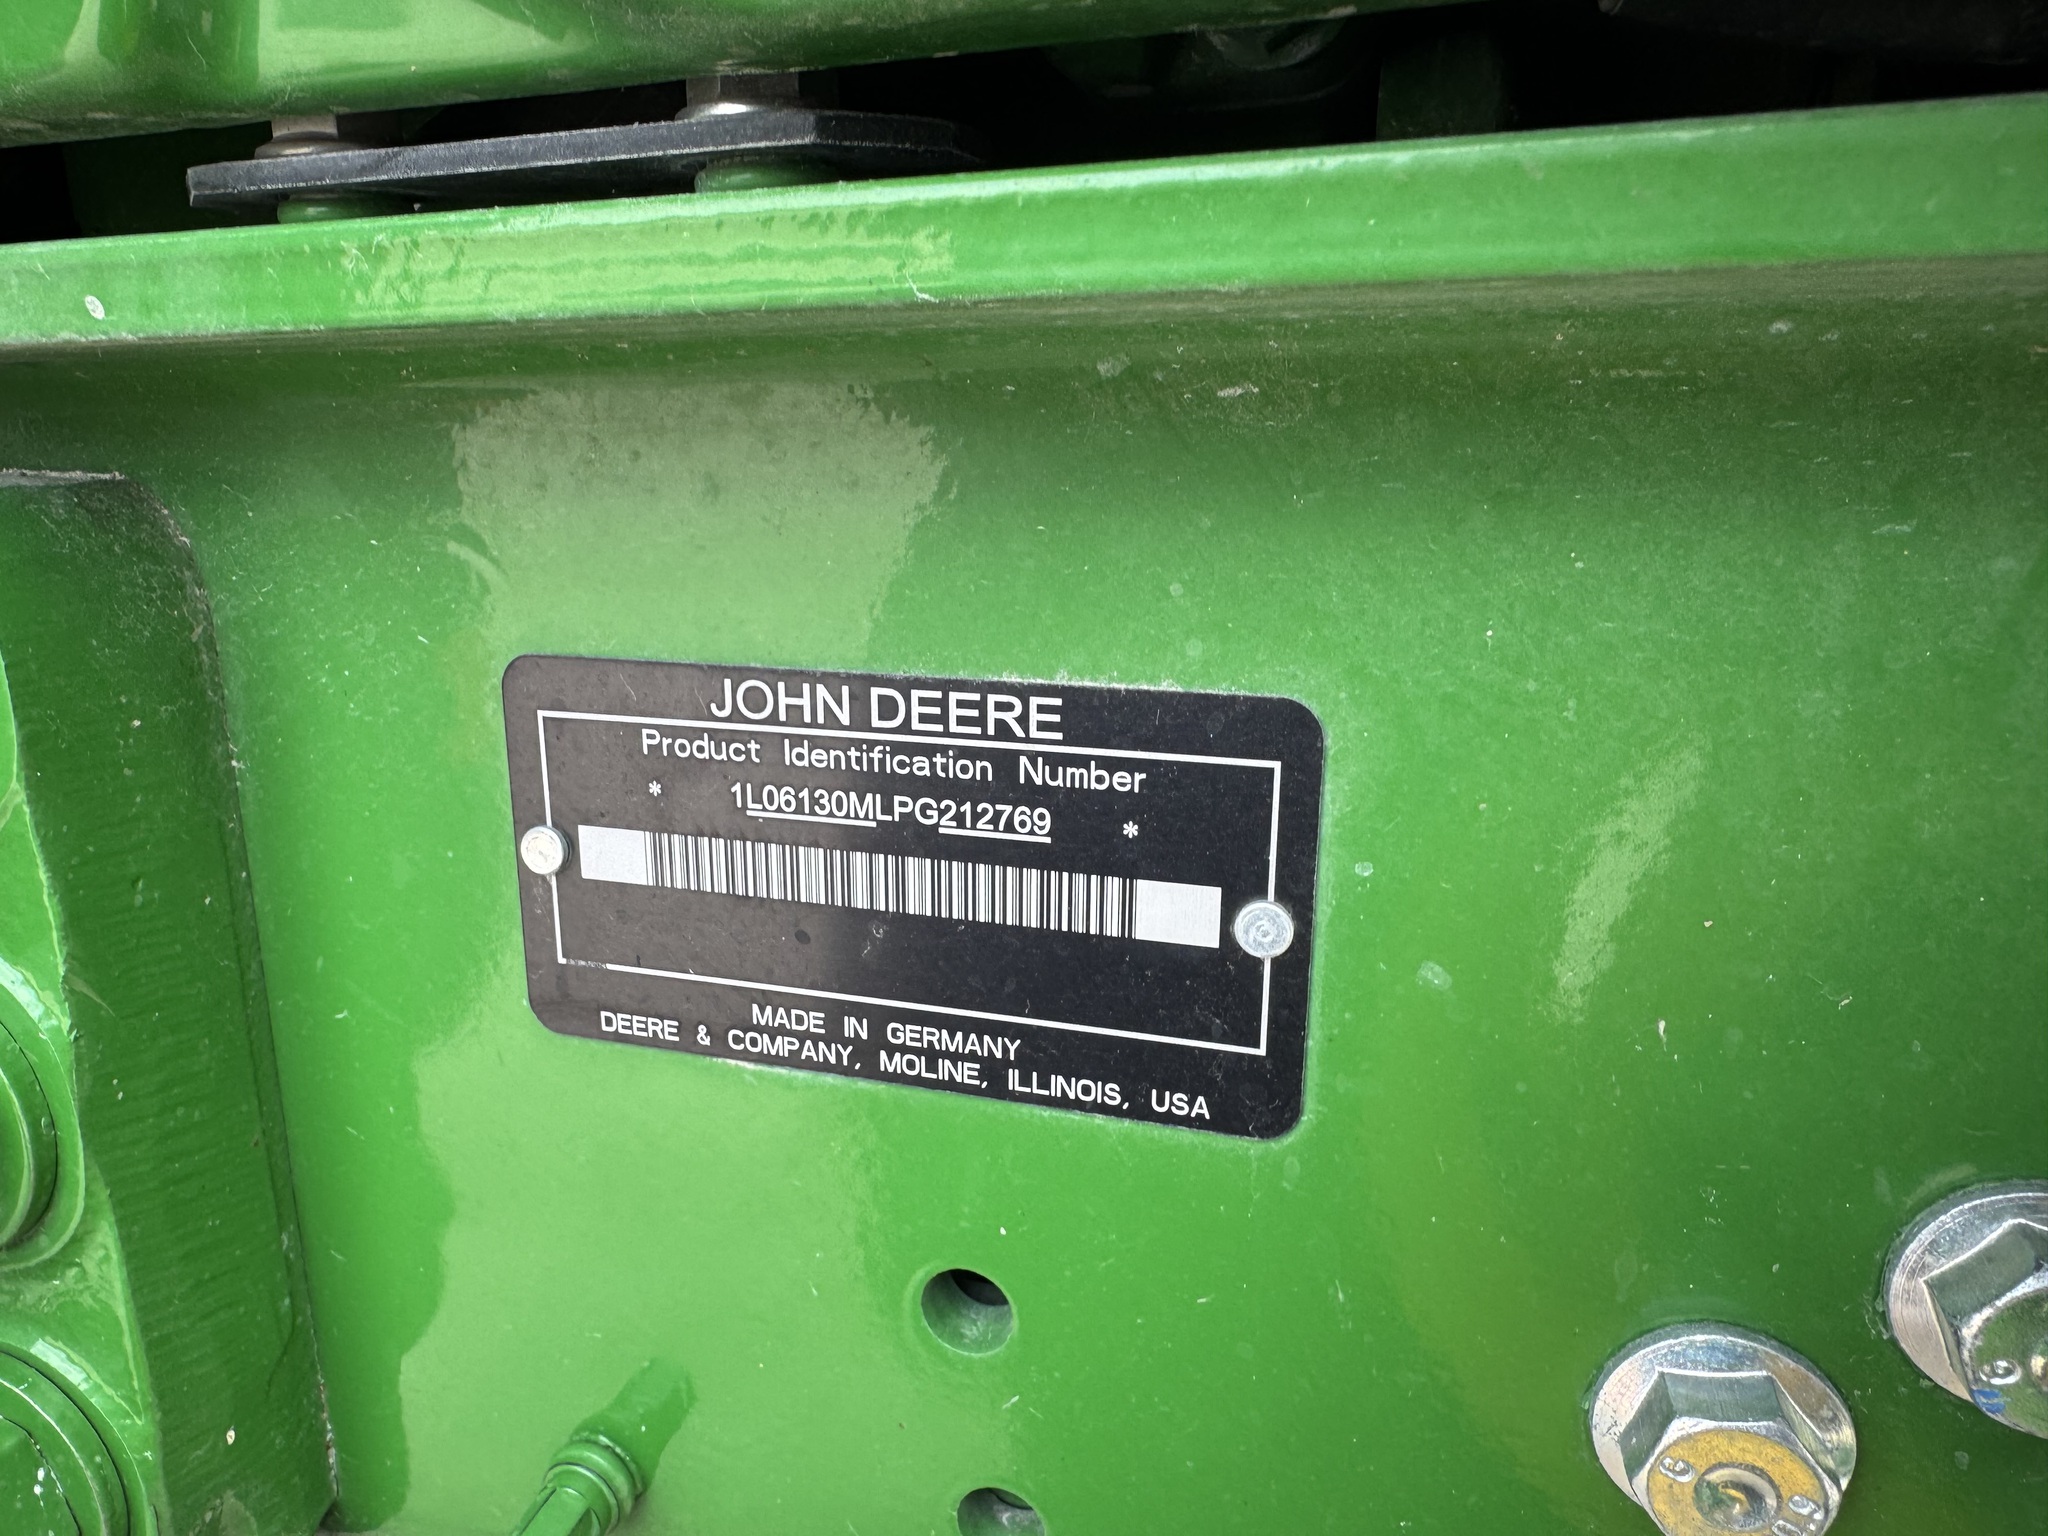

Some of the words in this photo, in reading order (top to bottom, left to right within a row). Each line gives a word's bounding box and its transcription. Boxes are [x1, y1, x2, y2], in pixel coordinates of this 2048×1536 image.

[709, 677, 852, 727] JOHN
[869, 686, 1064, 741] DEERE
[641, 727, 761, 765] Product
[782, 738, 994, 783] Identification
[1019, 755, 1147, 795] Number
[730, 781, 1052, 841] 1L06130MLPG212769
[751, 1003, 826, 1034] MADE
[843, 1015, 868, 1040] IN
[886, 1022, 1021, 1062] GERMANY
[599, 1010, 680, 1042] DEERE
[696, 1024, 711, 1047] &
[727, 1028, 860, 1075] COMPANY,
[879, 1049, 986, 1094] MOLINE,
[1008, 1068, 1132, 1114] ILLINOIS,
[1151, 1088, 1210, 1120] USA
